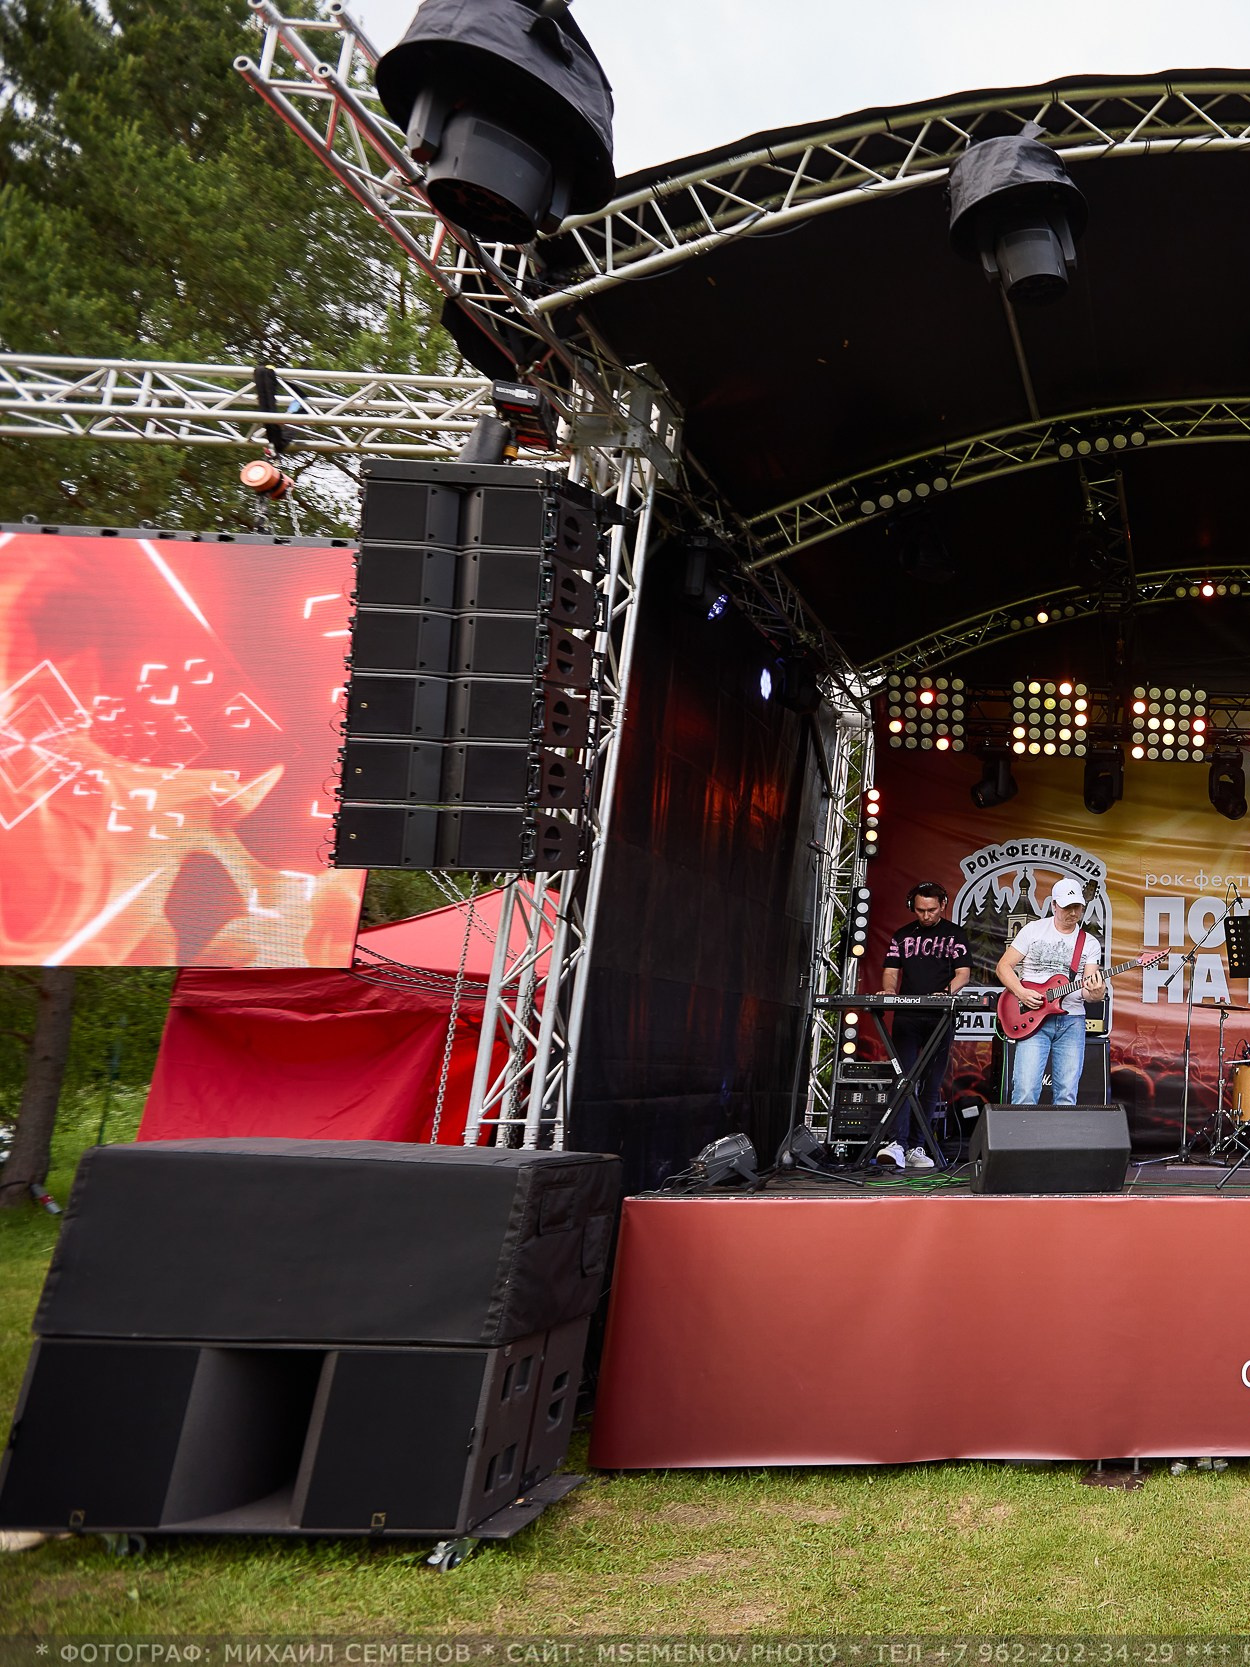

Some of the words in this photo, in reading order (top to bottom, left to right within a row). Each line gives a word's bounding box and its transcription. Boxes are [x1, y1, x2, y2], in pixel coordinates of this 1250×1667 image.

[965, 843, 1101, 878] РОК-ФЕСТИВАЛЬ
[1142, 953, 1232, 1004] НА
[893, 996, 921, 1004] Roland
